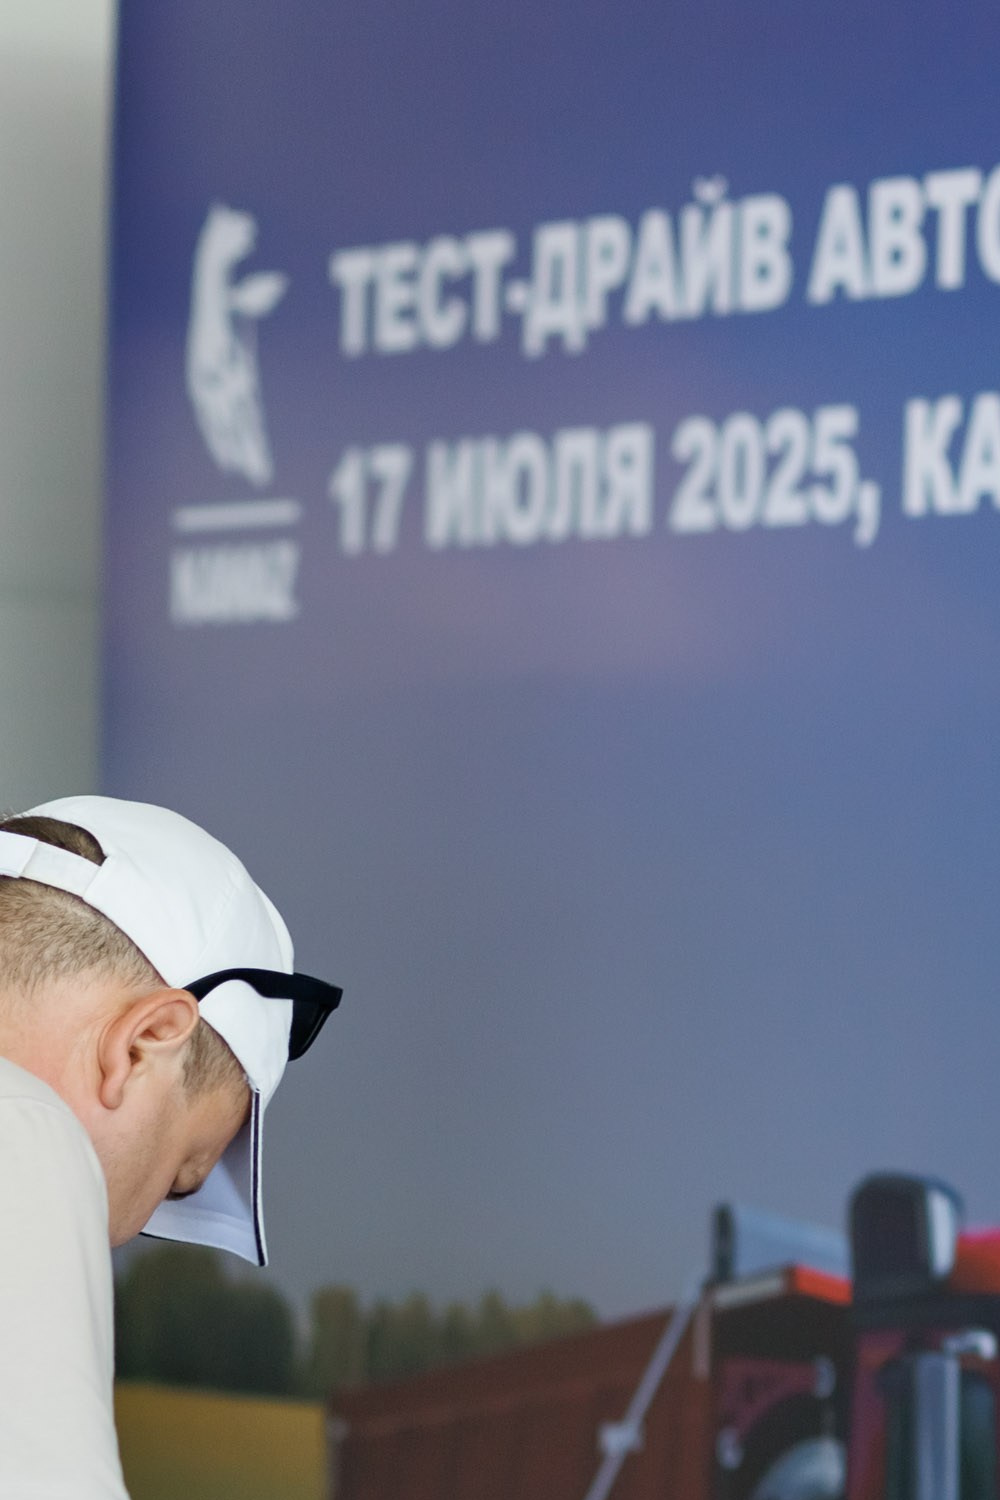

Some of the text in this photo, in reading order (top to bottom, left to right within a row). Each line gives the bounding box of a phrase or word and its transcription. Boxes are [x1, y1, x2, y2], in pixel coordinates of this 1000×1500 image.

[332, 178, 790, 357] ТЕСТ-ДРАЙВ
[330, 445, 412, 555] 17
[424, 422, 654, 551] ИЮЛЯ
[668, 405, 880, 547] 2025,
